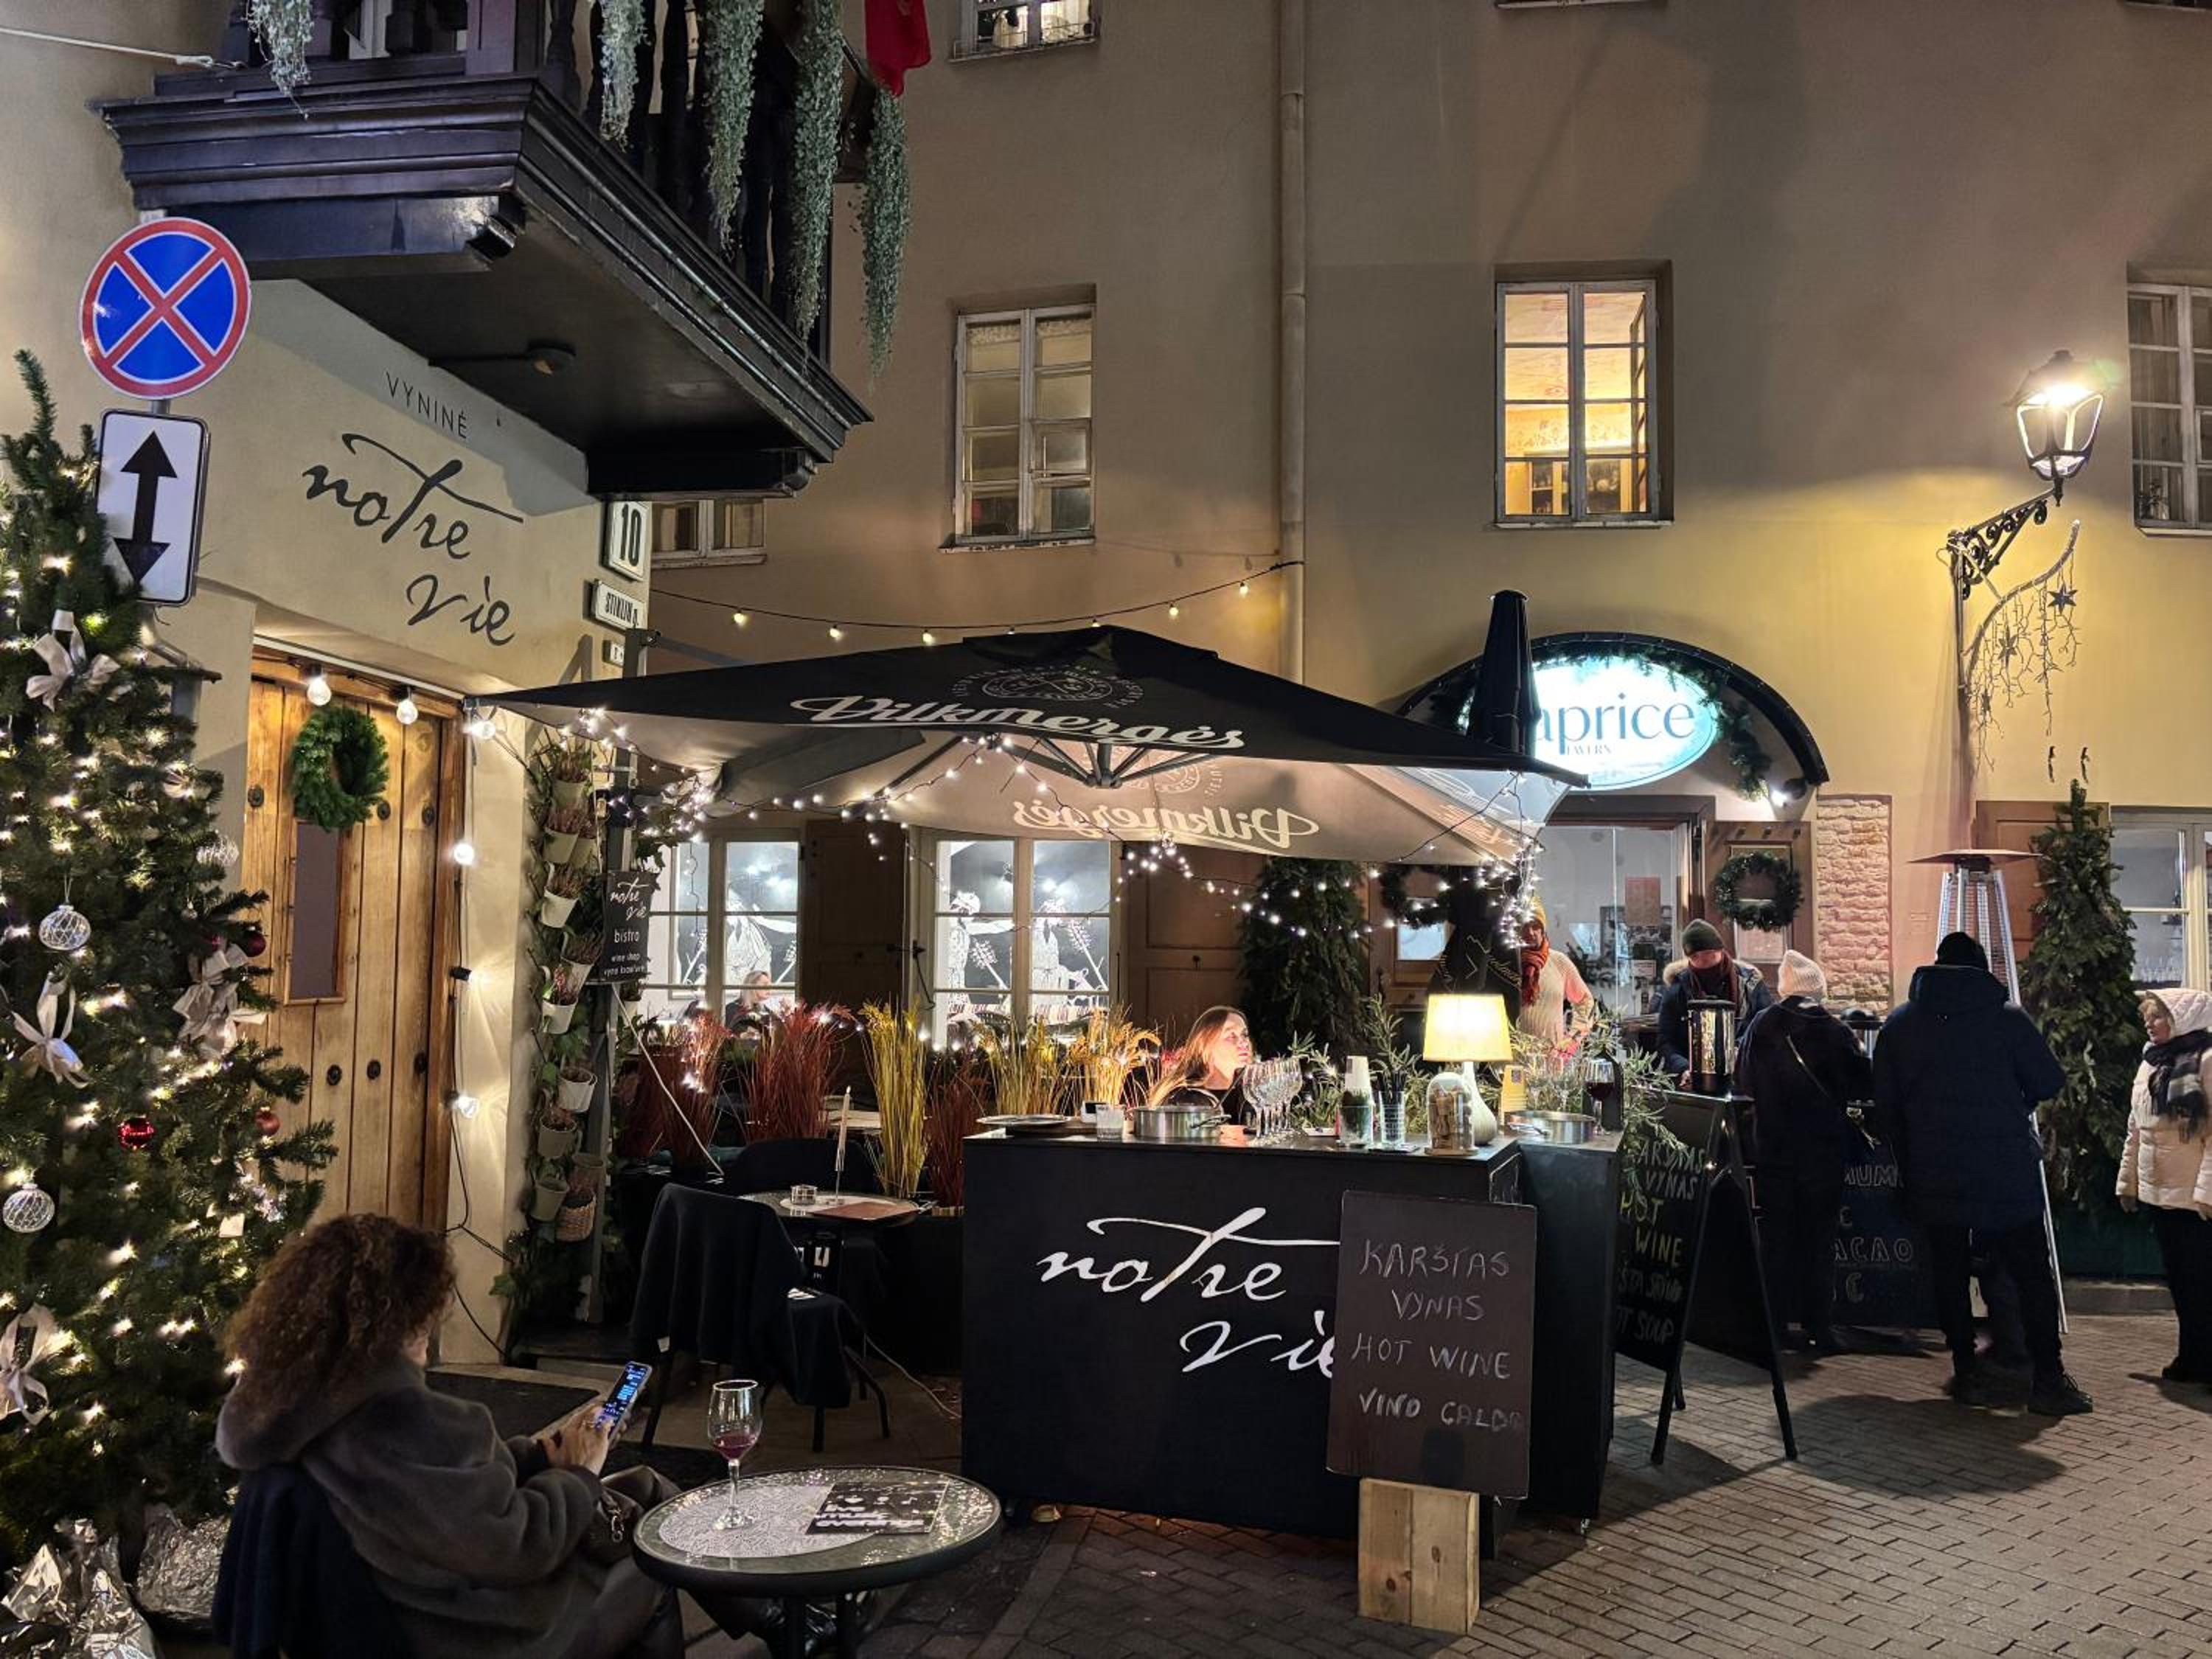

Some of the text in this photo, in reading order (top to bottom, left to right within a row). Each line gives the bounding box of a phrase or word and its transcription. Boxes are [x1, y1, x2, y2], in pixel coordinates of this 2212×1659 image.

[385, 372, 467, 439] VYNINĖ
[620, 504, 642, 567] 10
[790, 695, 1246, 749] Vilkmergės
[1359, 1239, 1510, 1279] KARŠTAS
[1635, 1226, 1684, 1268] WINE
[1391, 1289, 1486, 1321] VYNAS
[1351, 1332, 1512, 1380] HOT WINE
[1359, 1387, 1422, 1419] VINO
